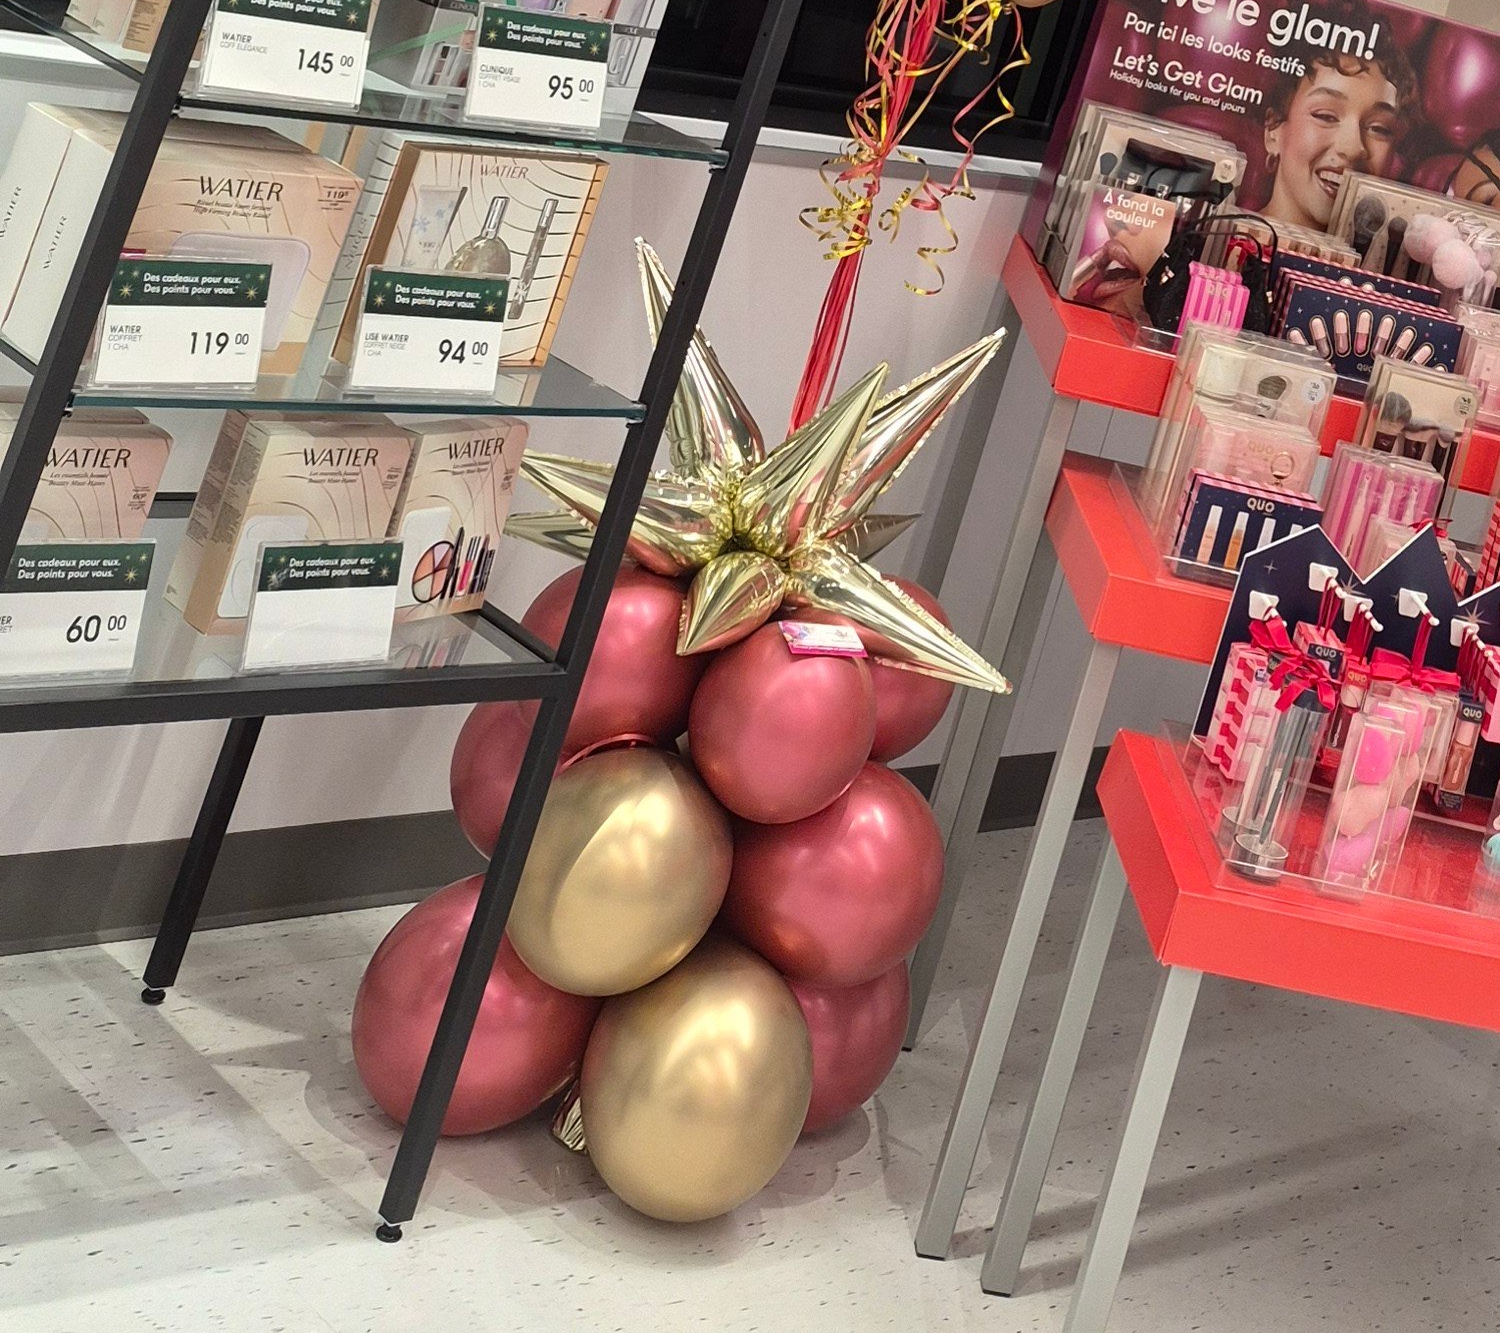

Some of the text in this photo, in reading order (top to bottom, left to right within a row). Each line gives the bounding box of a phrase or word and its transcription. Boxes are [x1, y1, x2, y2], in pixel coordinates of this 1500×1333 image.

[295, 4, 315, 14] pour
[222, 32, 252, 42] WATIER
[507, 21, 520, 30] Des
[522, 24, 552, 35] cadeaux
[554, 30, 571, 38] pour
[1266, 3, 1380, 60] glam!
[507, 31, 563, 47] Des points pour
[1123, 12, 1307, 77] Par ici les looks festifs
[298, 49, 354, 74] 145 00
[480, 64, 514, 74] CLINIQUE
[549, 75, 594, 100] 95 00
[1163, 61, 1204, 89] Get
[1208, 73, 1263, 105] Glam
[1109, 69, 1246, 115] Holiday looks for you and yours
[480, 164, 529, 180] WATIER
[200, 176, 283, 201] WATIER
[1103, 189, 1164, 217] À fond la
[1106, 208, 1157, 229] couleur
[43, 216, 67, 269] WATIER
[143, 272, 160, 282] Des
[162, 273, 199, 283] cadeaux
[201, 276, 222, 284] pour
[144, 284, 212, 296] Des points pour
[395, 284, 410, 293] Des
[412, 286, 444, 296] cadeaux
[446, 290, 464, 298] pour
[395, 295, 410, 304] Des
[411, 297, 435, 306] points
[110, 325, 141, 333] WATIER
[108, 334, 142, 342] COFFRET
[191, 332, 249, 355] 119 00
[365, 333, 409, 343] LISE WATIER
[439, 339, 488, 364] 94 00
[449, 437, 505, 460] WATIER
[45, 448, 131, 468] WATIER
[303, 447, 379, 467] WATIER
[1246, 498, 1275, 513] QUO
[18, 558, 35, 568] Des
[38, 558, 76, 567] cadeaux
[79, 560, 100, 568] pour
[289, 558, 303, 567] Des
[306, 558, 338, 566] cadeaux
[340, 559, 358, 567] pour
[18, 570, 35, 579] Des
[37, 570, 65, 580] points
[67, 572, 89, 580] pour
[289, 569, 303, 578] Des
[306, 569, 329, 579] points
[66, 615, 127, 643] 60 00
[1315, 646, 1337, 659] QUO
[1462, 707, 1483, 720] QUO
